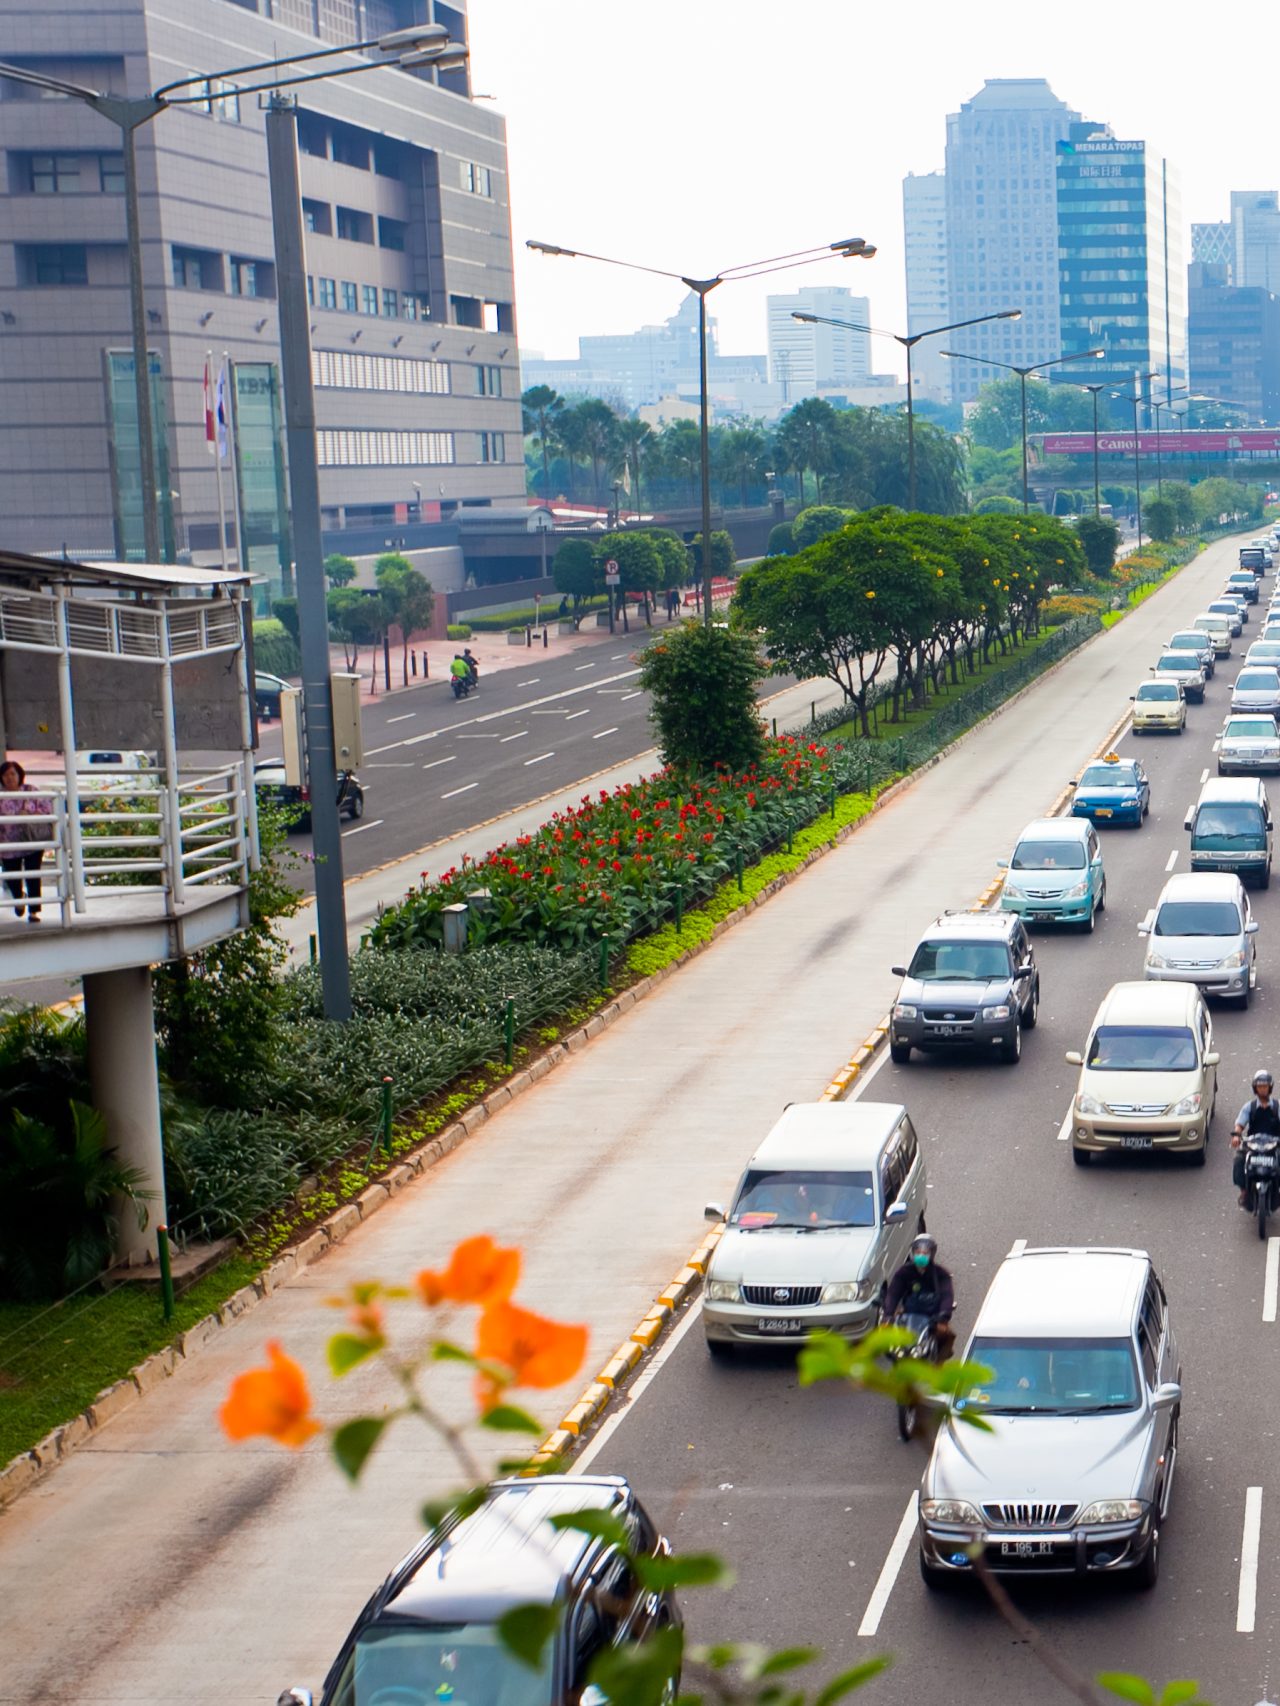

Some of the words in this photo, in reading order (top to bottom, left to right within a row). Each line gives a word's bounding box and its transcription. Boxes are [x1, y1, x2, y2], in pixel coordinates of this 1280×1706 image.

[1075, 143, 1115, 153] MENARA
[1114, 142, 1145, 151] TOPAS
[238, 377, 277, 395] IBM
[1096, 438, 1142, 450] Canon
[1001, 1541, 1009, 1554] B
[1015, 1541, 1033, 1553] 195
[1039, 1541, 1053, 1553] RT
